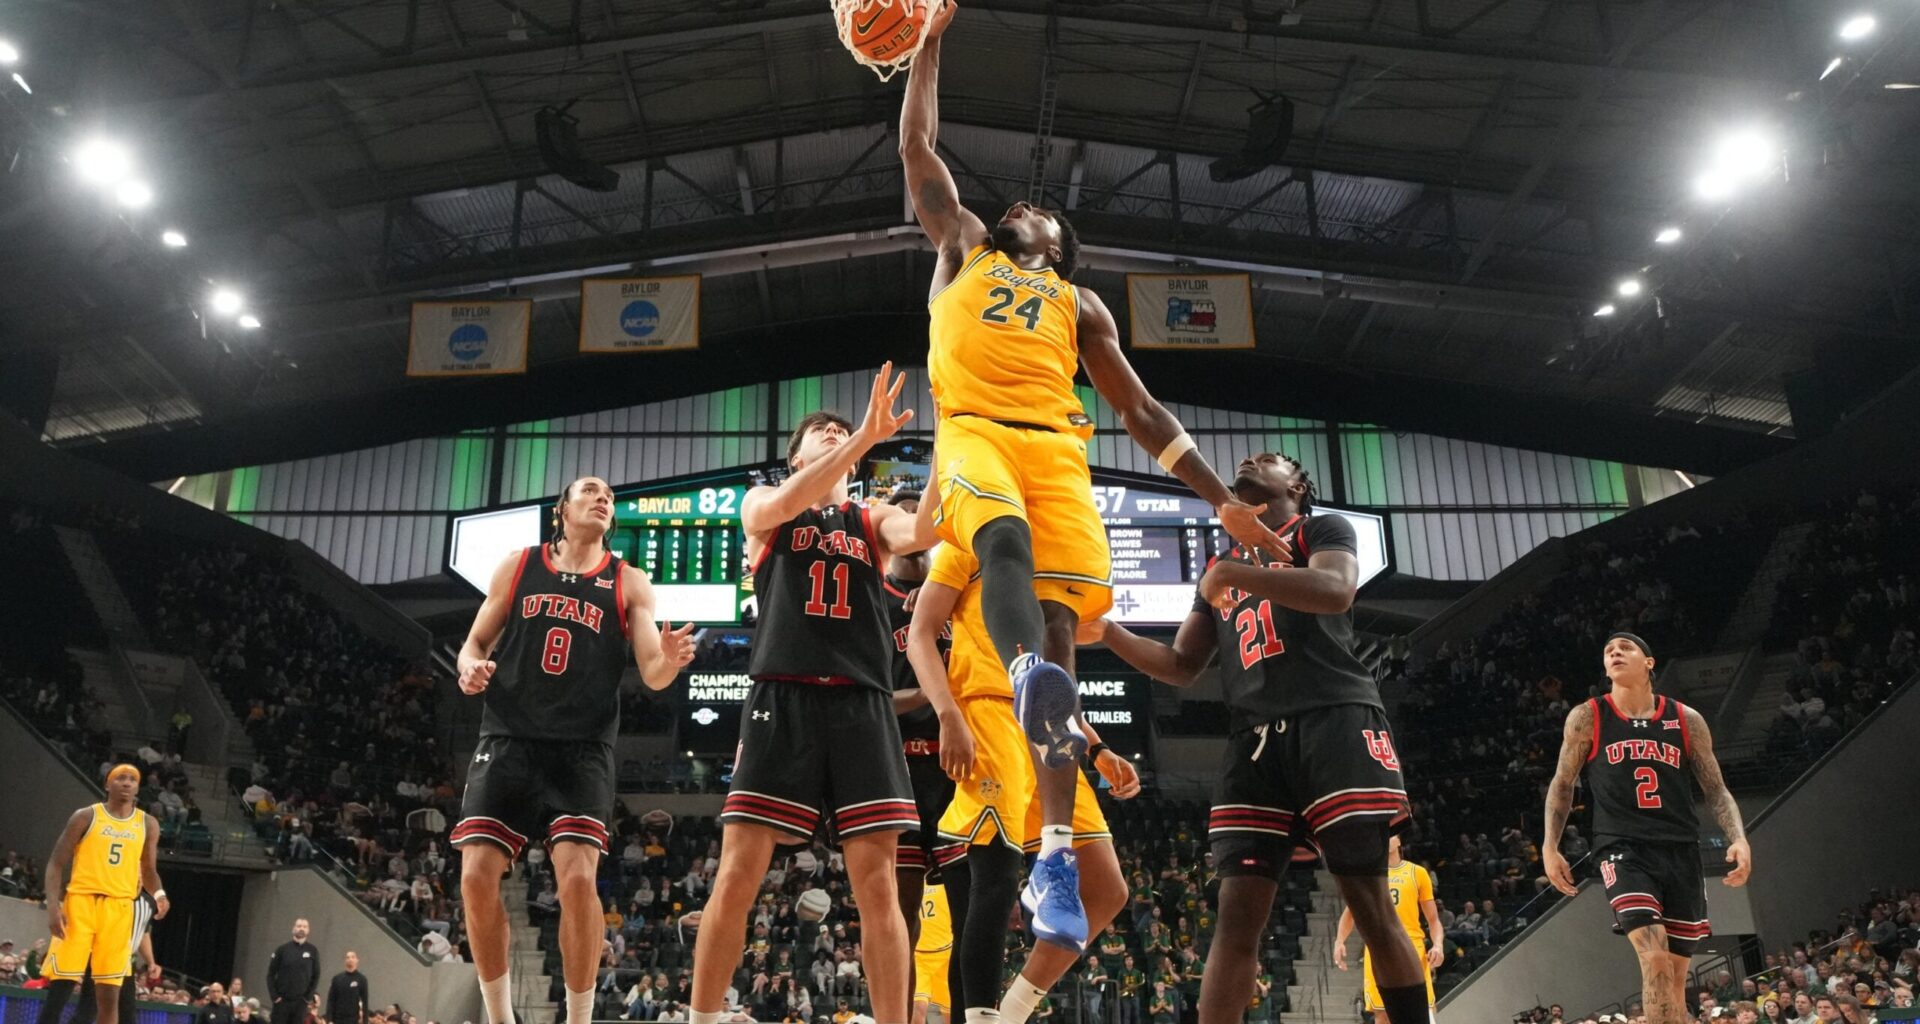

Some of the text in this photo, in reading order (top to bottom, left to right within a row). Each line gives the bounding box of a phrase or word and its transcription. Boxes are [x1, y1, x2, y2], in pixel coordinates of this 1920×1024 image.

[984, 264, 1059, 299] Baylor
[1168, 280, 1209, 290] BAYLOR
[621, 282, 660, 294] BAYLOR
[451, 307, 490, 317] BAYLOR
[980, 286, 1043, 332] 24
[623, 317, 660, 328] NCAA
[638, 488, 736, 514] BAYLOR 82
[1092, 486, 1181, 513] 57 UTAH
[1110, 529, 1143, 538] BROWN
[1186, 529, 1196, 537] 12
[697, 540, 703, 549] 1
[791, 526, 872, 567] UTAH
[1110, 540, 1142, 548] DAWES
[1111, 550, 1161, 558] LANGARITA
[672, 560, 678, 569] 1
[1112, 560, 1141, 569] ABBEY
[721, 571, 727, 580] 1
[1113, 570, 1148, 579] TRAORE
[805, 560, 851, 620] 11
[522, 594, 604, 634] UTAH
[1236, 599, 1285, 670] 21
[541, 626, 572, 675] 8
[689, 674, 755, 687] CHAMPIO
[1088, 711, 1132, 723] TRAILERS
[1606, 740, 1680, 769] UTAH
[1634, 767, 1662, 808] 2
[109, 843, 123, 865] 5
